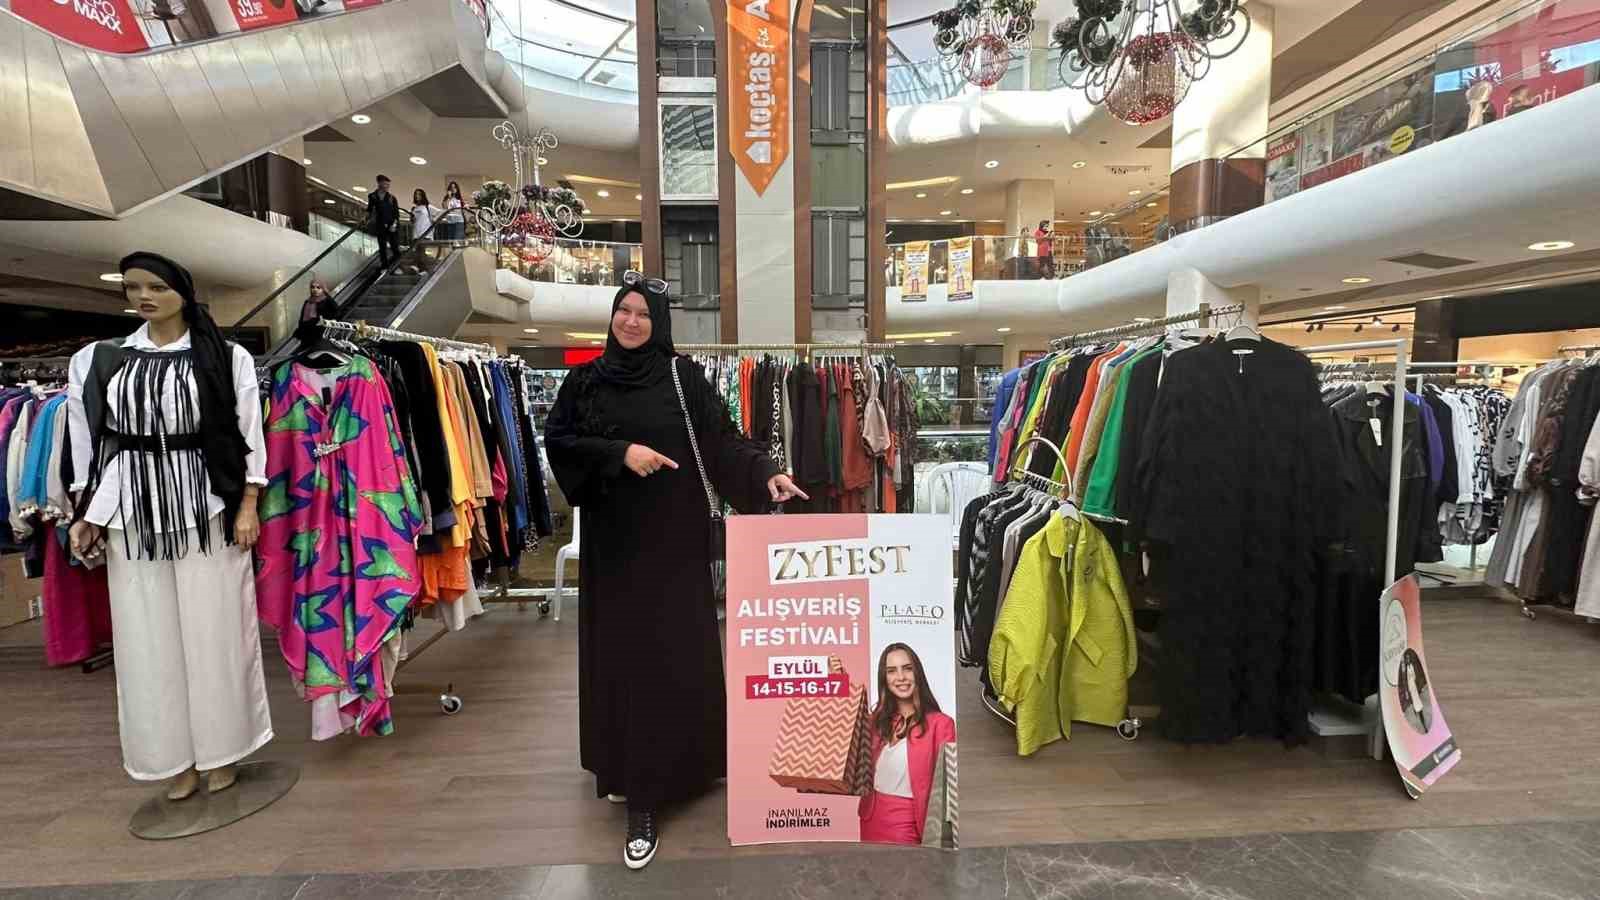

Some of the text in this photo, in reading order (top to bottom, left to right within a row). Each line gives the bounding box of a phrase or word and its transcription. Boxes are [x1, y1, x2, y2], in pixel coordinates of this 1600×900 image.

[744, 52, 776, 138] koçtaş
[736, 593, 861, 621] ALIŞVERİŞ
[740, 622, 859, 647] FESTİVALİ
[774, 659, 822, 675] EYLÜL
[752, 681, 841, 696] 14-15-16-17
[766, 816, 831, 829] İNDİRİMLER
